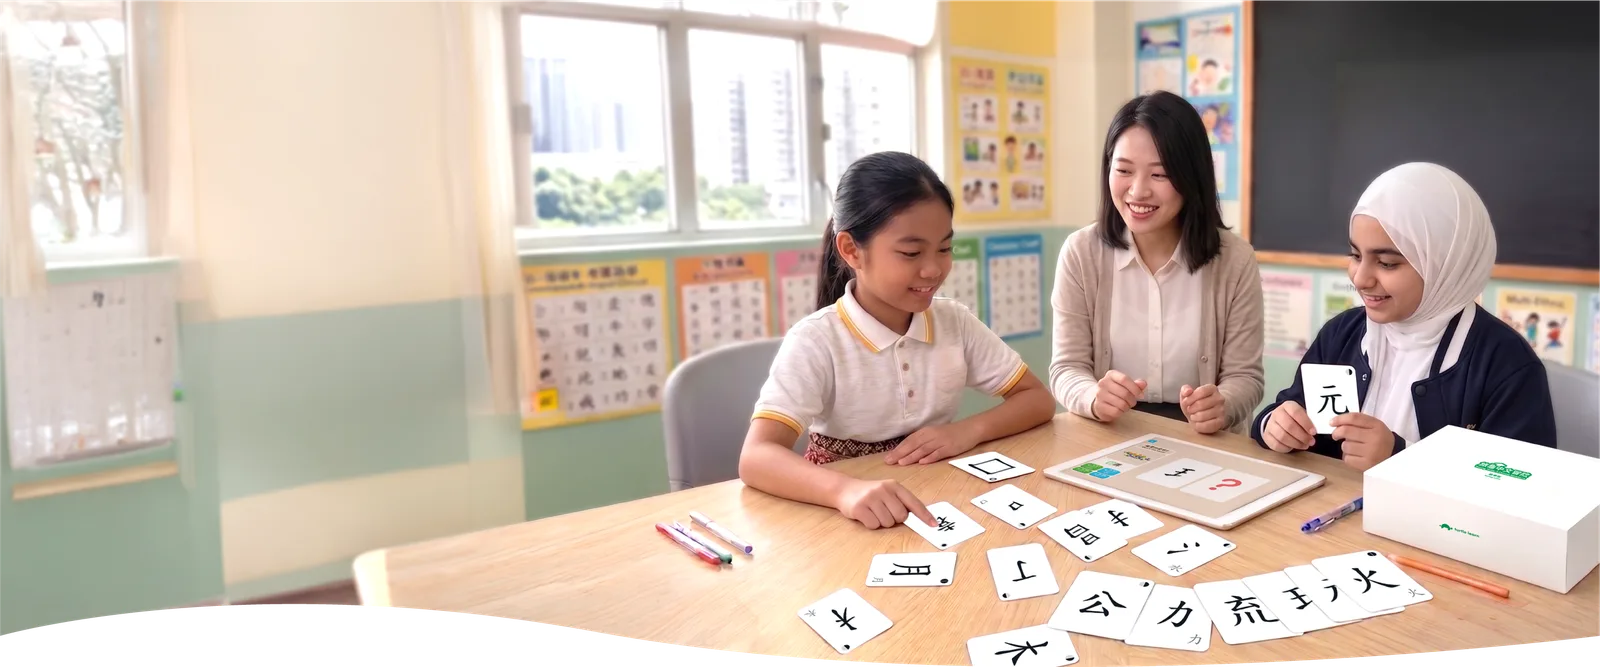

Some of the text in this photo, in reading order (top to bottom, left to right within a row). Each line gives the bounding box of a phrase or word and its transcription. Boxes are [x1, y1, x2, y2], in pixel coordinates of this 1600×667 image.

[1317, 385, 1350, 416] 元
[1208, 478, 1242, 491] ?
[1009, 502, 1023, 510] 口
[1064, 524, 1100, 545] 昌
[889, 563, 931, 575] 月
[1352, 568, 1399, 593] 火
[1079, 591, 1126, 616] 公
[1157, 601, 1192, 627] 力
[1188, 633, 1202, 645] 力
[994, 640, 1049, 667] 木
